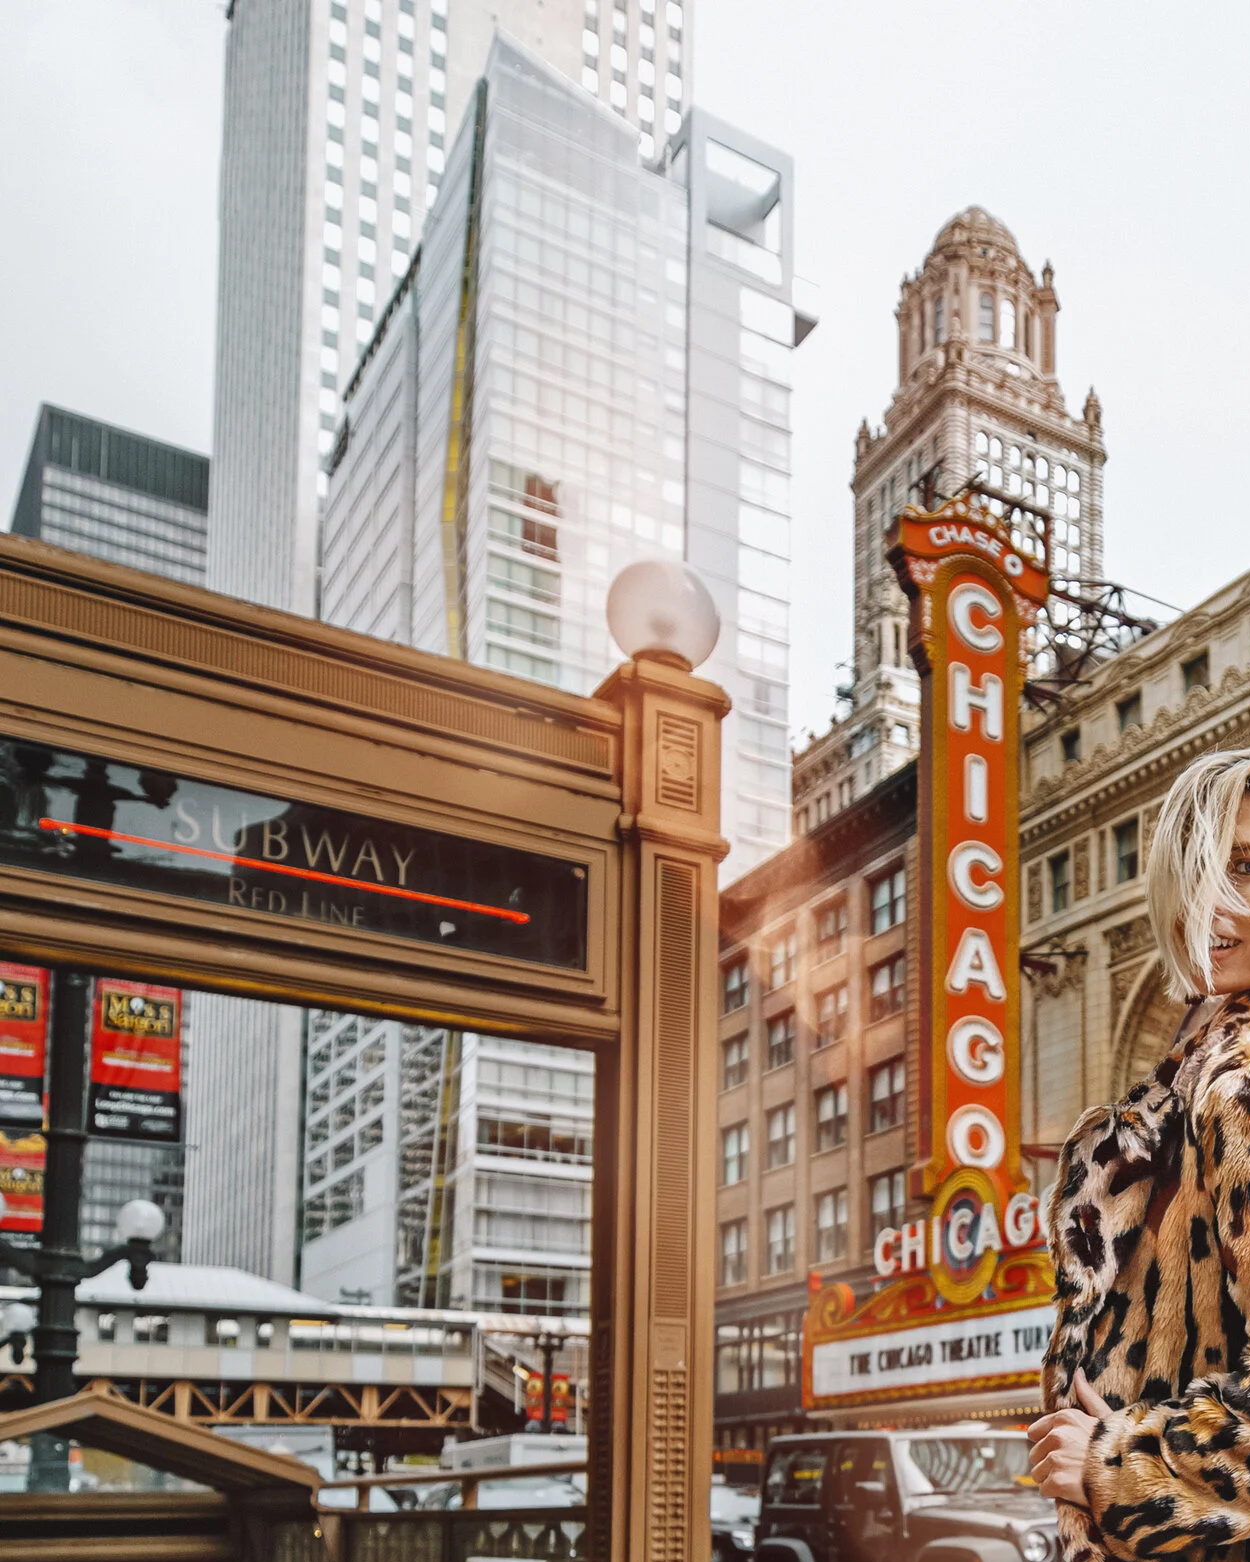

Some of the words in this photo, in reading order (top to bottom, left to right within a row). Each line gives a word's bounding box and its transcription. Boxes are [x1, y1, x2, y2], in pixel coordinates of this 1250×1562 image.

[928, 524, 1003, 558] CHASE
[174, 797, 415, 886] SUBWAY
[946, 581, 1006, 1169] CHICAGO
[229, 877, 287, 912] RED
[300, 890, 365, 926] LINE
[850, 1352, 871, 1376] THE
[878, 1341, 933, 1372] CHICAGO
[940, 1332, 1002, 1363] THEATRE
